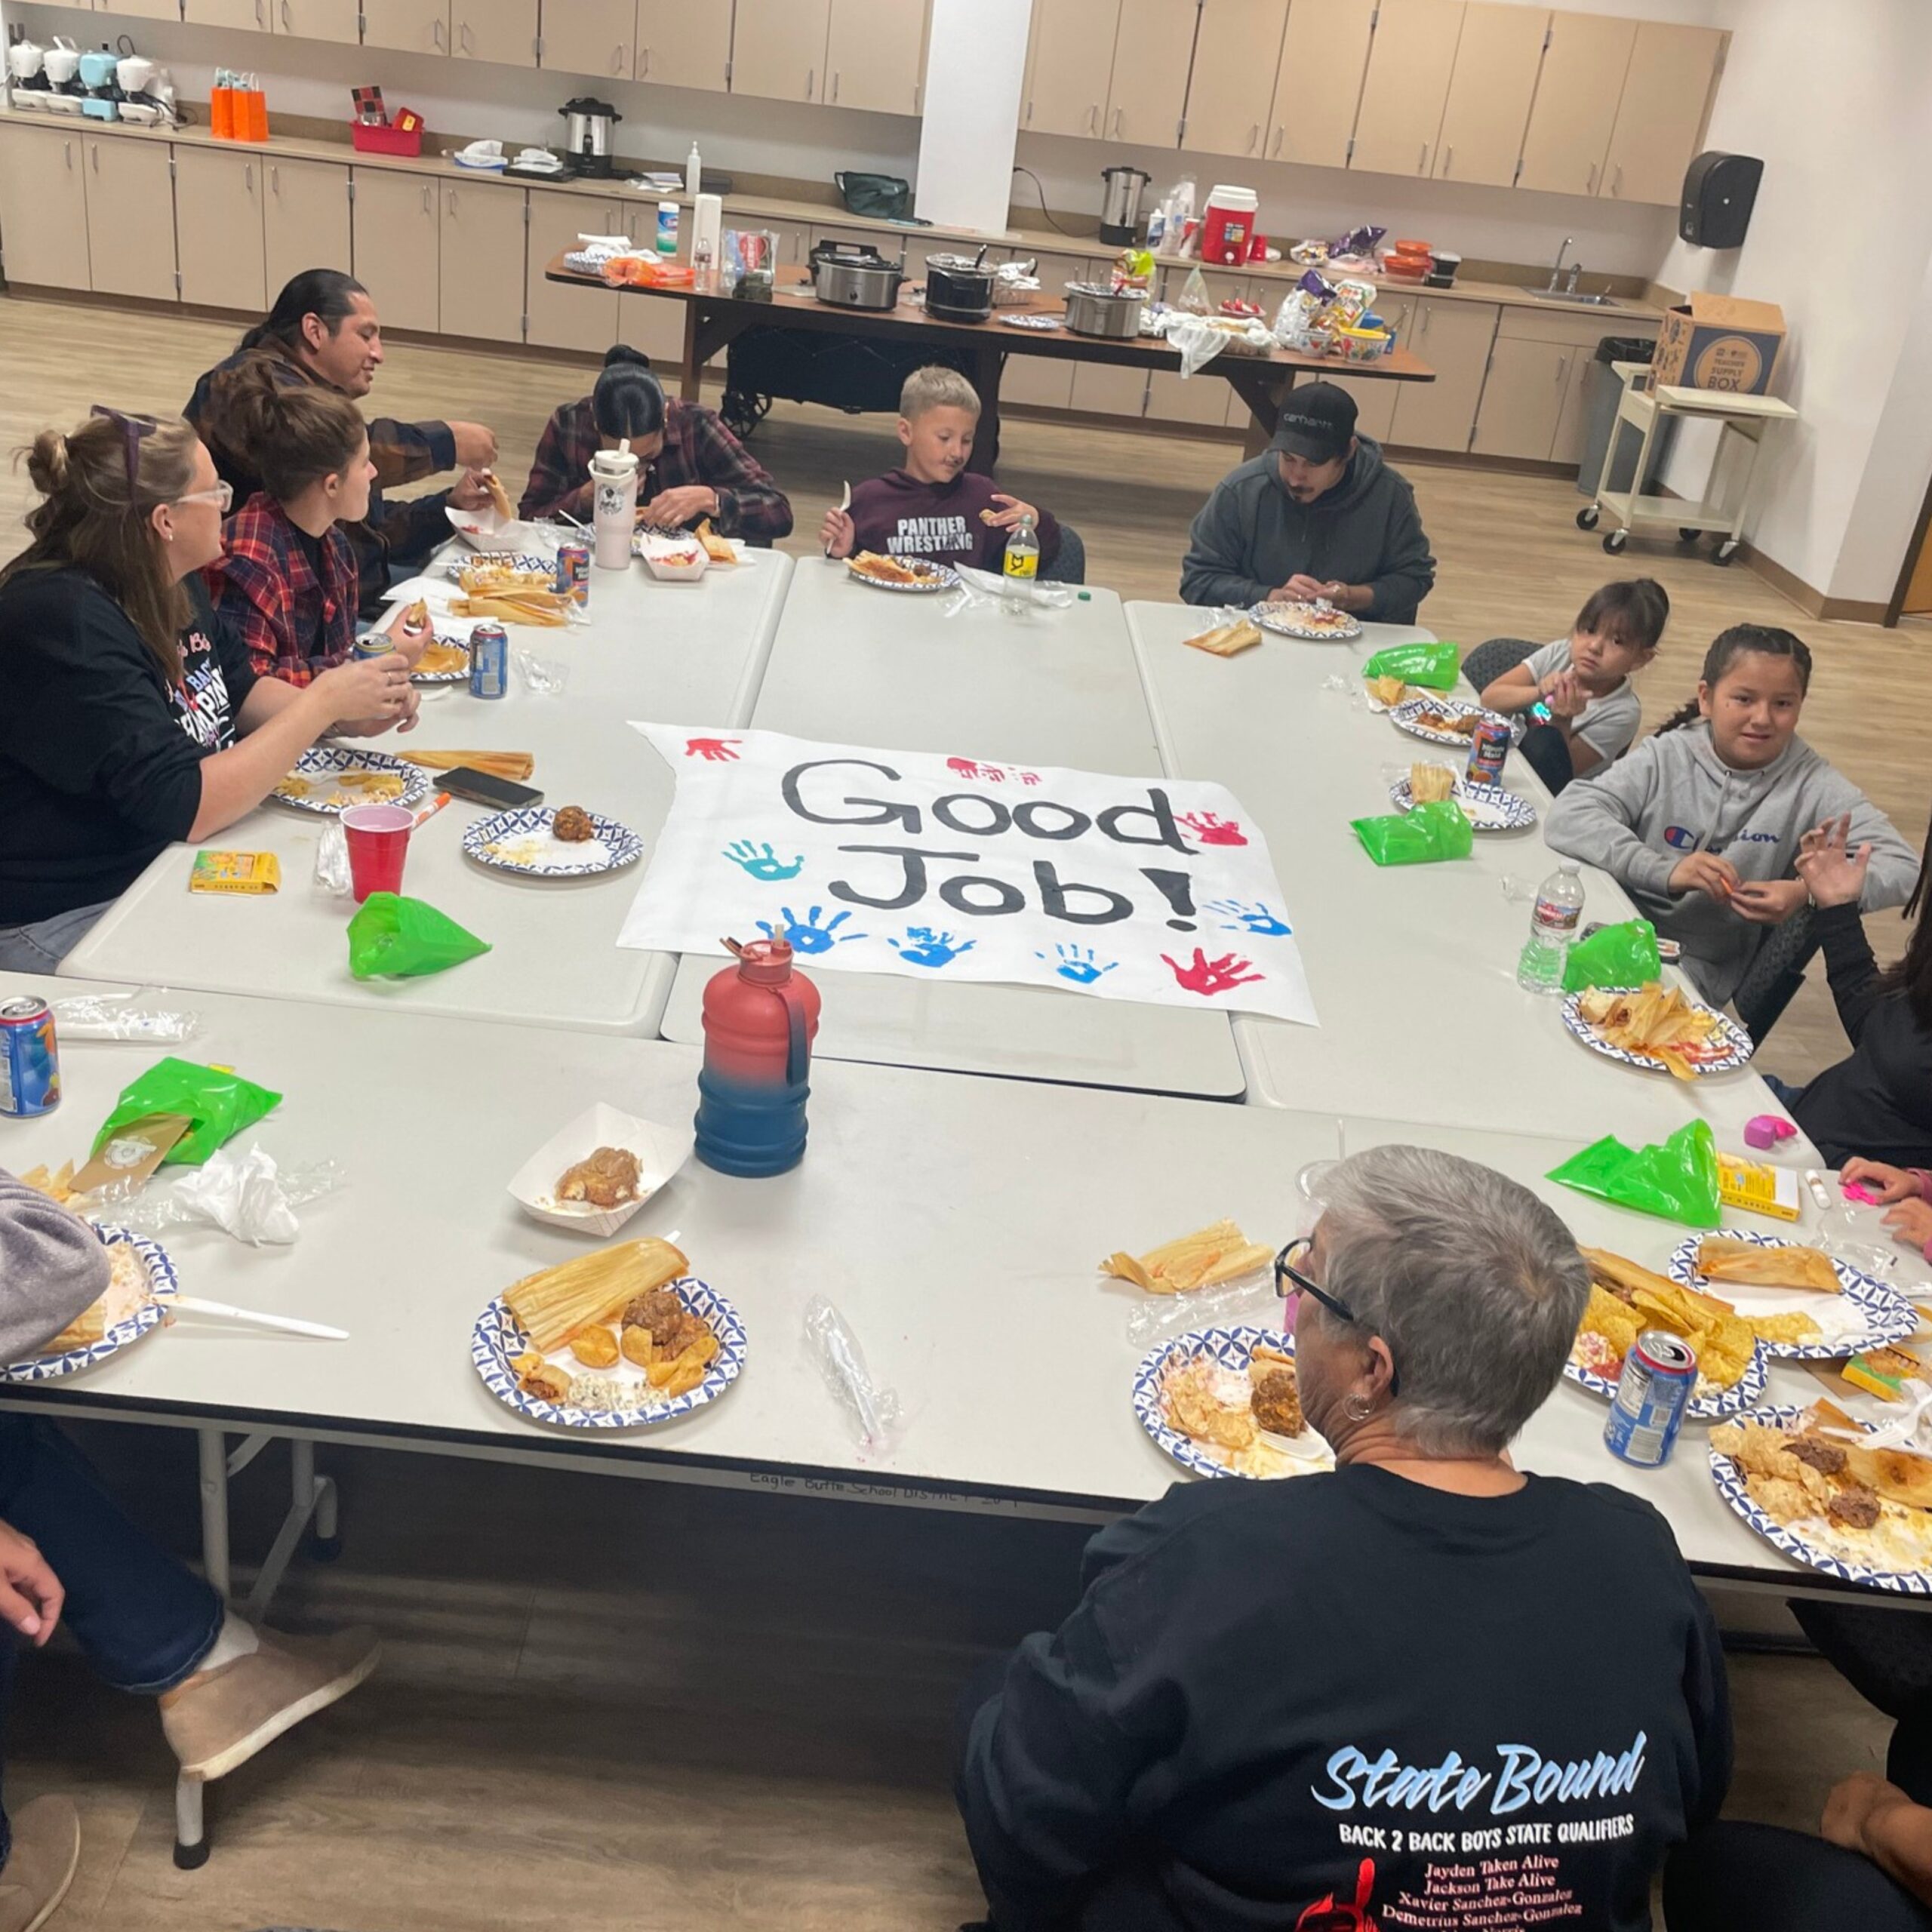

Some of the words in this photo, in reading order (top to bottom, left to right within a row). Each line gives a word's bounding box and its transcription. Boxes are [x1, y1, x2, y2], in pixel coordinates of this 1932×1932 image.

[1710, 366, 1744, 377] SUPPLY
[1707, 376, 1741, 392] BOX
[897, 516, 967, 537] PANTHER
[780, 758, 1200, 856] Good
[827, 844, 1198, 932] Job!
[1310, 1744, 1492, 1814] State
[1489, 1730, 1647, 1814] Bound
[1338, 1823, 1386, 1850] BACK
[1391, 1830, 1403, 1853] 2
[1408, 1831, 1457, 1853] BACK
[1461, 1827, 1502, 1853] BOYS
[1506, 1823, 1552, 1845] STATE
[1557, 1813, 1635, 1844] QUALIFIERS
[1424, 1863, 1475, 1881] Jayden
[1479, 1857, 1518, 1876] Taken
[1521, 1854, 1560, 1870] Alive
[1423, 1879, 1481, 1896] Jackson
[1484, 1875, 1515, 1892] Take
[1518, 1872, 1556, 1887] Alive
[1398, 1890, 1450, 1912] Xavier
[1381, 1903, 1459, 1927] Demetrius
